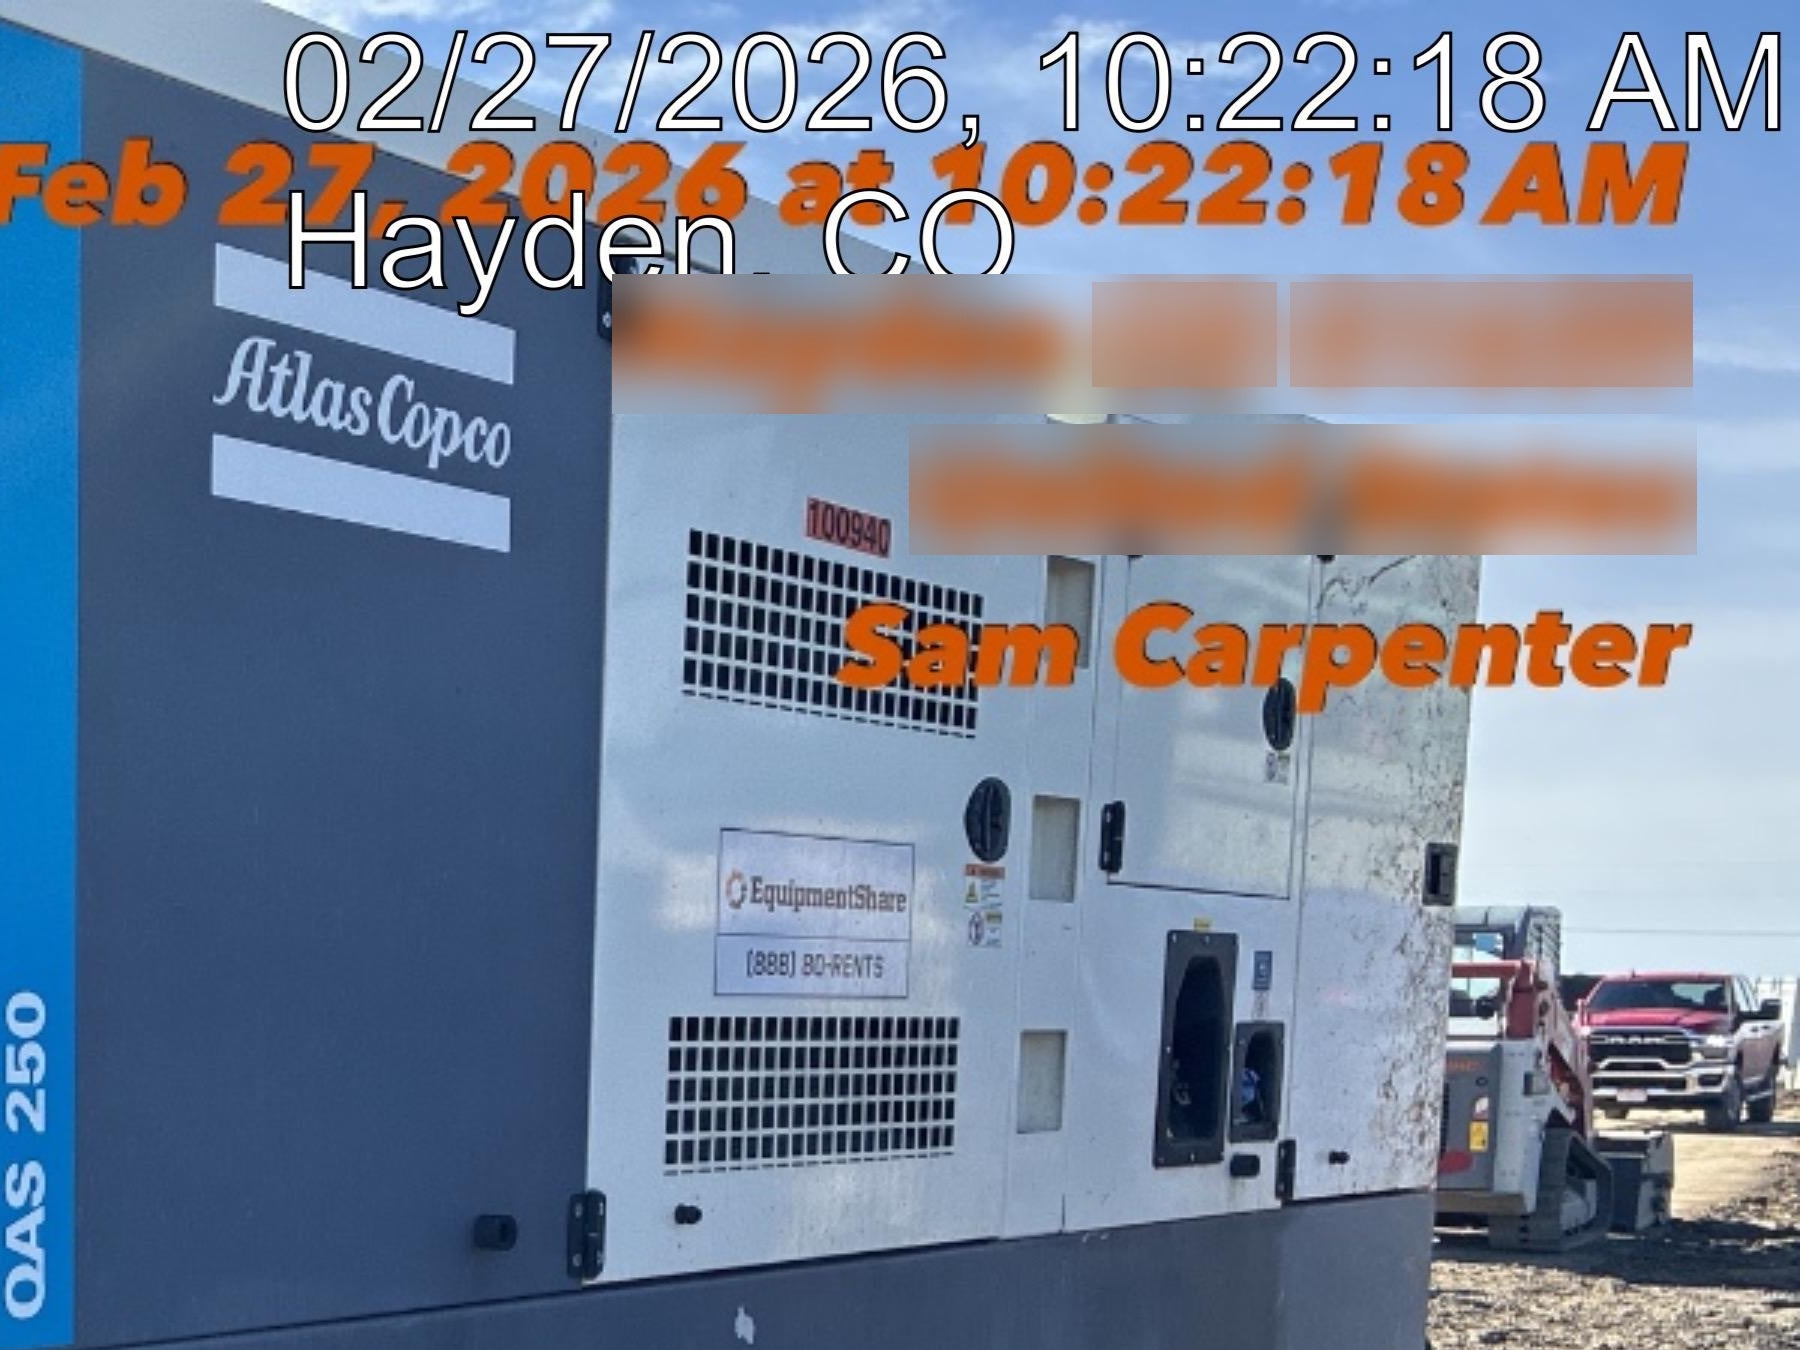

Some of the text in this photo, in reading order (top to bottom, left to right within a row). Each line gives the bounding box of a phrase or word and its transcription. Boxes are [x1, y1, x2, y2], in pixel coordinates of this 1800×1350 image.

[212, 335, 511, 469] Atlas Copco
[808, 498, 891, 557] 100940
[750, 875, 907, 913] EquipmentShare
[746, 948, 796, 978] (888)
[4, 990, 47, 1321] QAS 250
